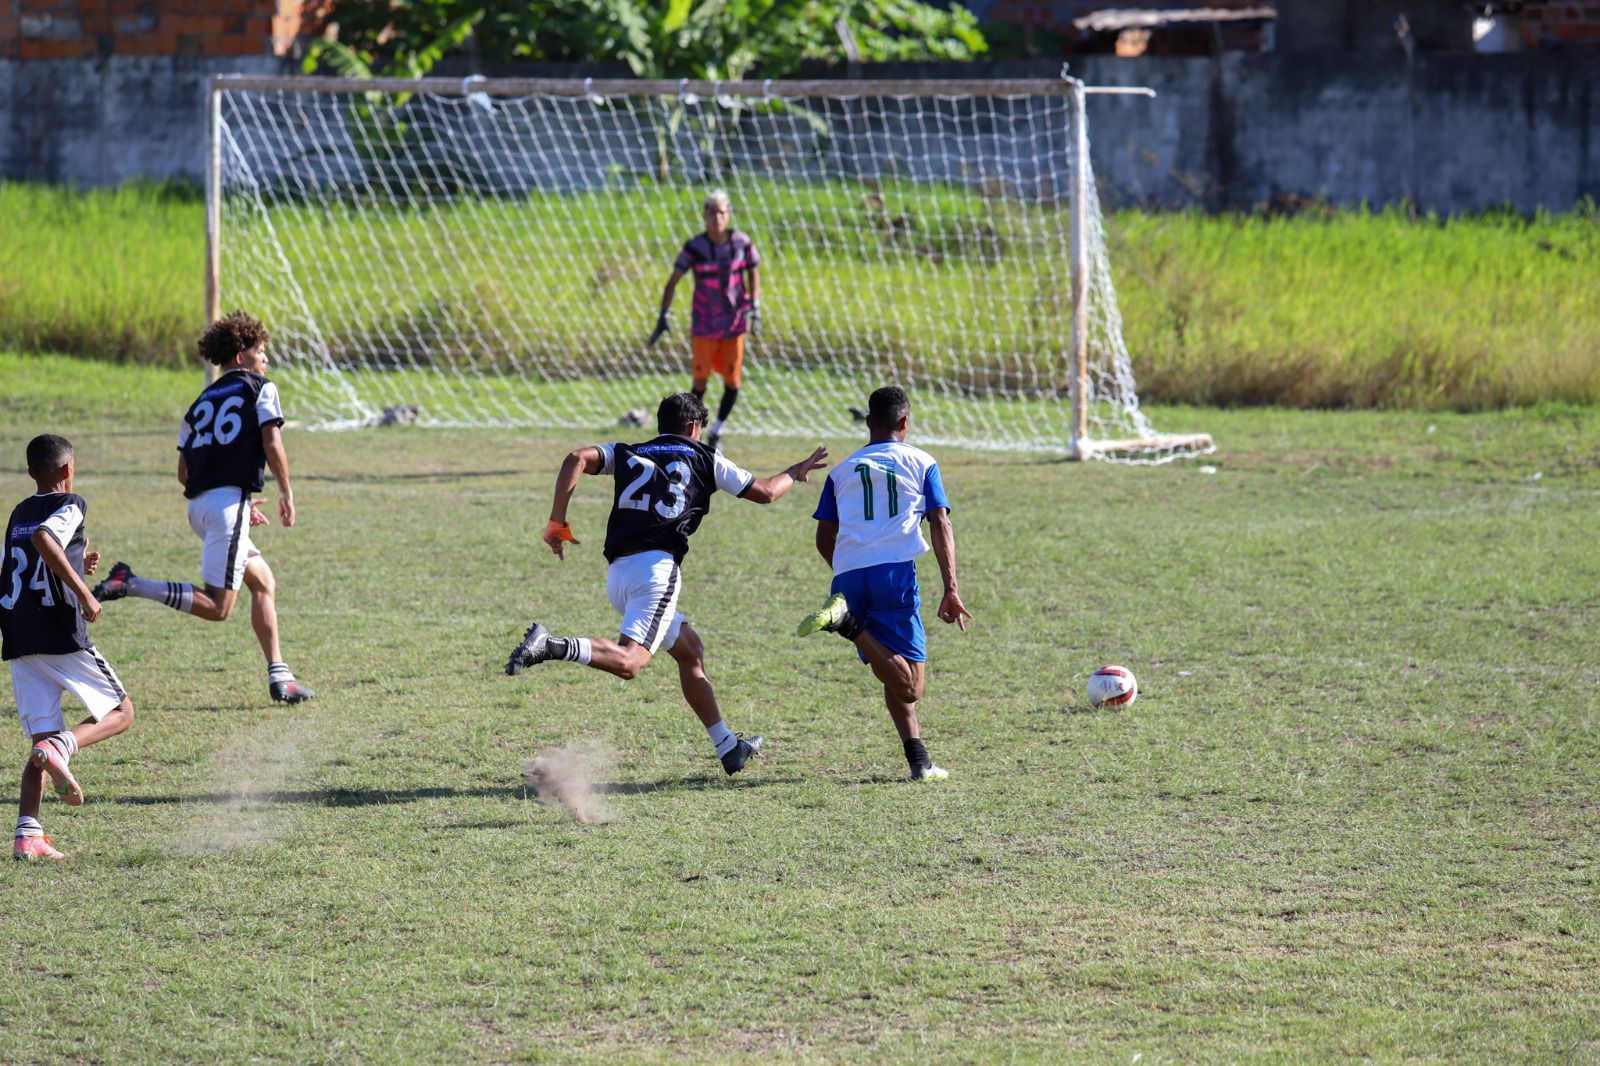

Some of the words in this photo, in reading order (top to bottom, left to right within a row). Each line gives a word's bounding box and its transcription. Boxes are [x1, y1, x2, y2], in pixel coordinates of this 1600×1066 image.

[191, 395, 245, 449] 26
[618, 455, 692, 519] 23
[854, 463, 899, 521] 11
[0, 546, 55, 610] 34
